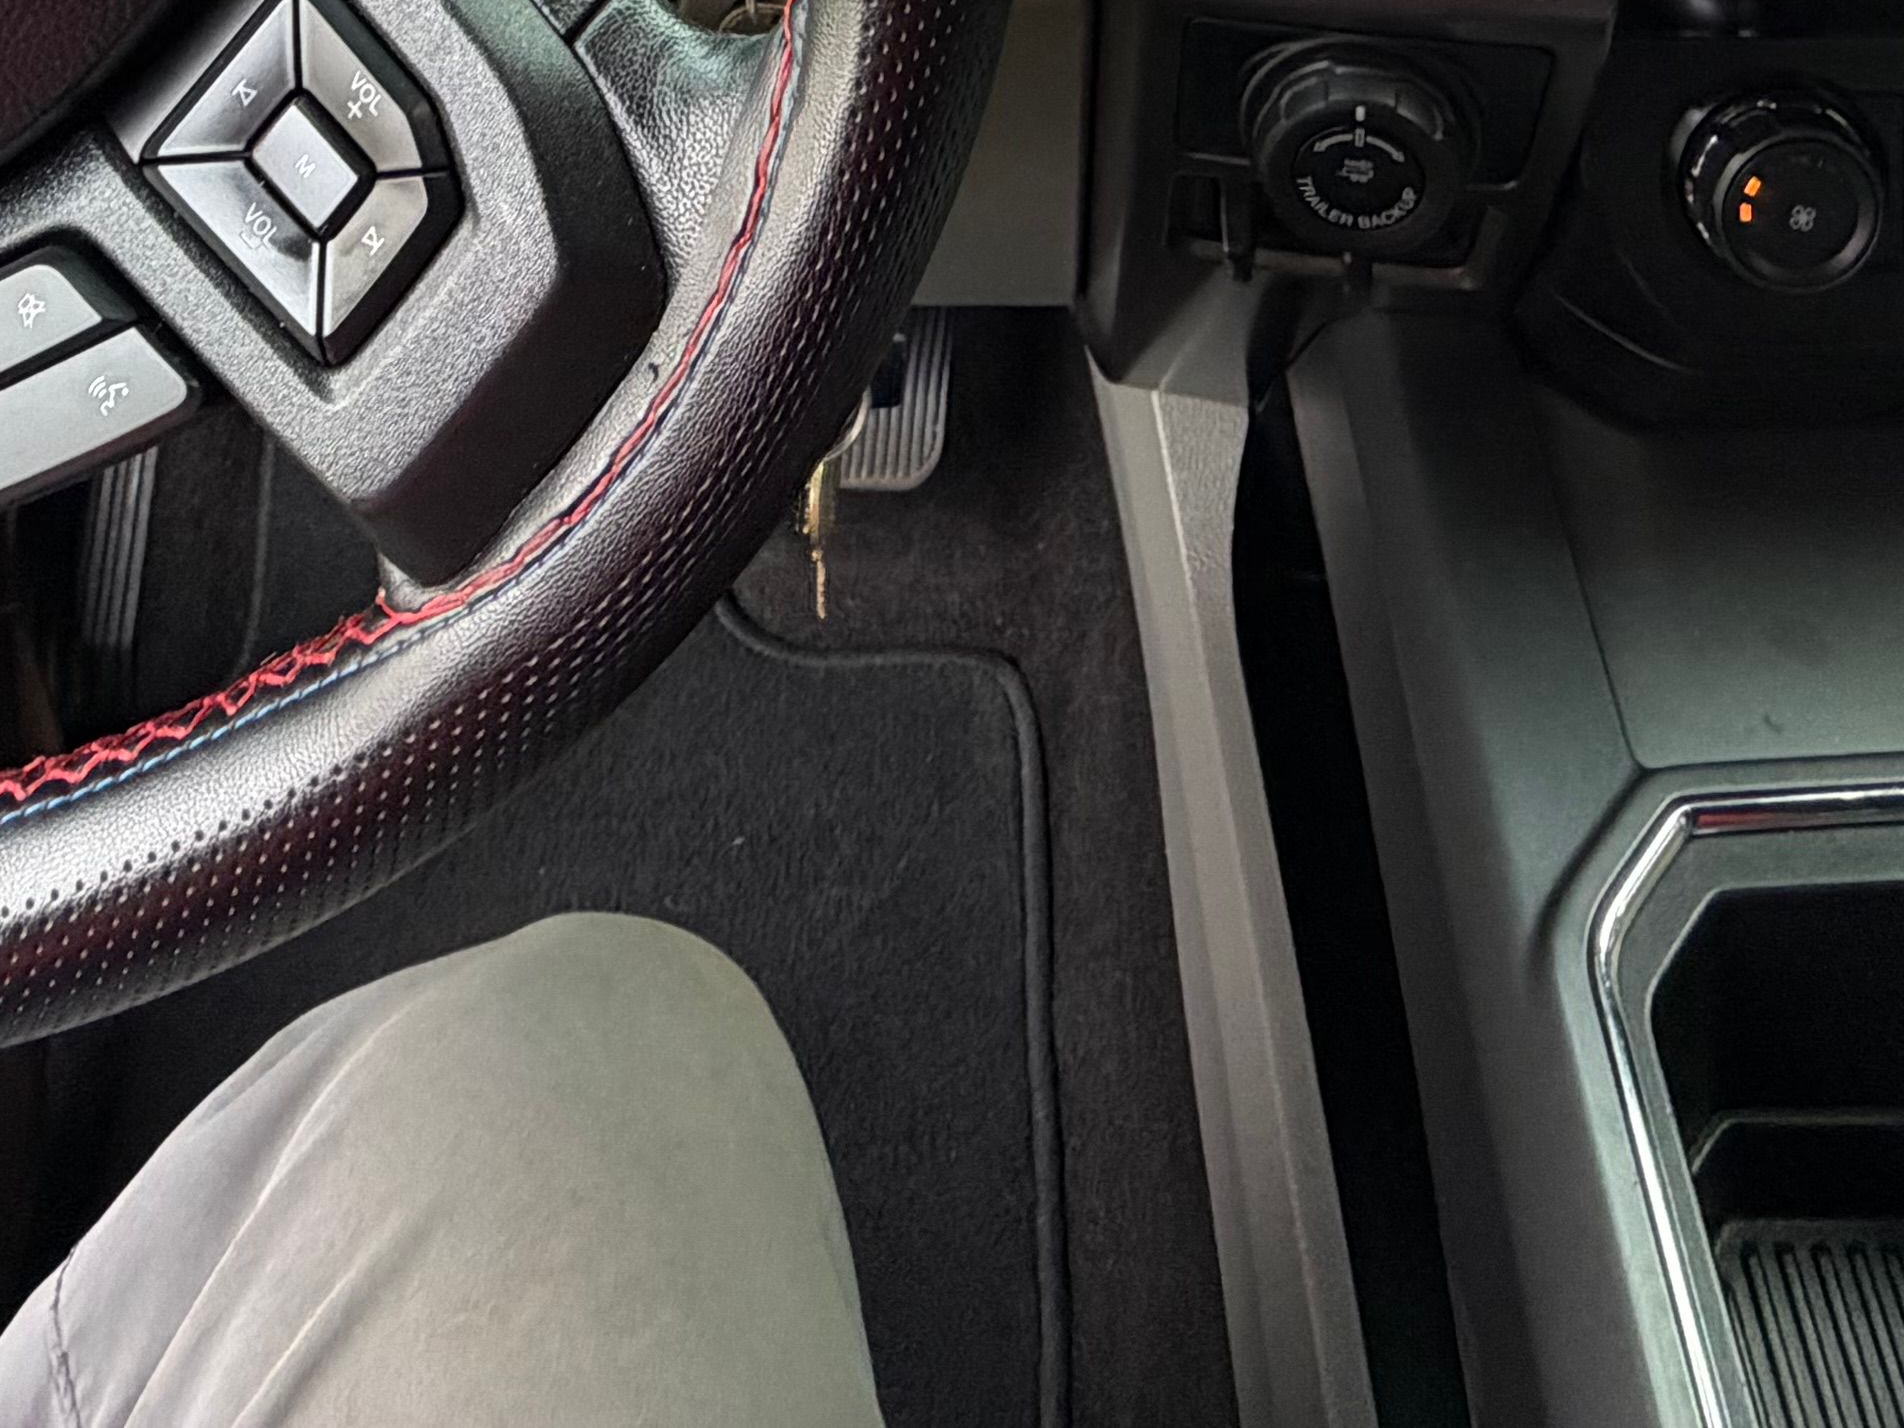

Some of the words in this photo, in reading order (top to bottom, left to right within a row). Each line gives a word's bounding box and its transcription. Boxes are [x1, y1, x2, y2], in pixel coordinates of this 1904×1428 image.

[349, 70, 383, 117] VOL
[294, 154, 316, 178] M
[243, 200, 279, 248] VOL
